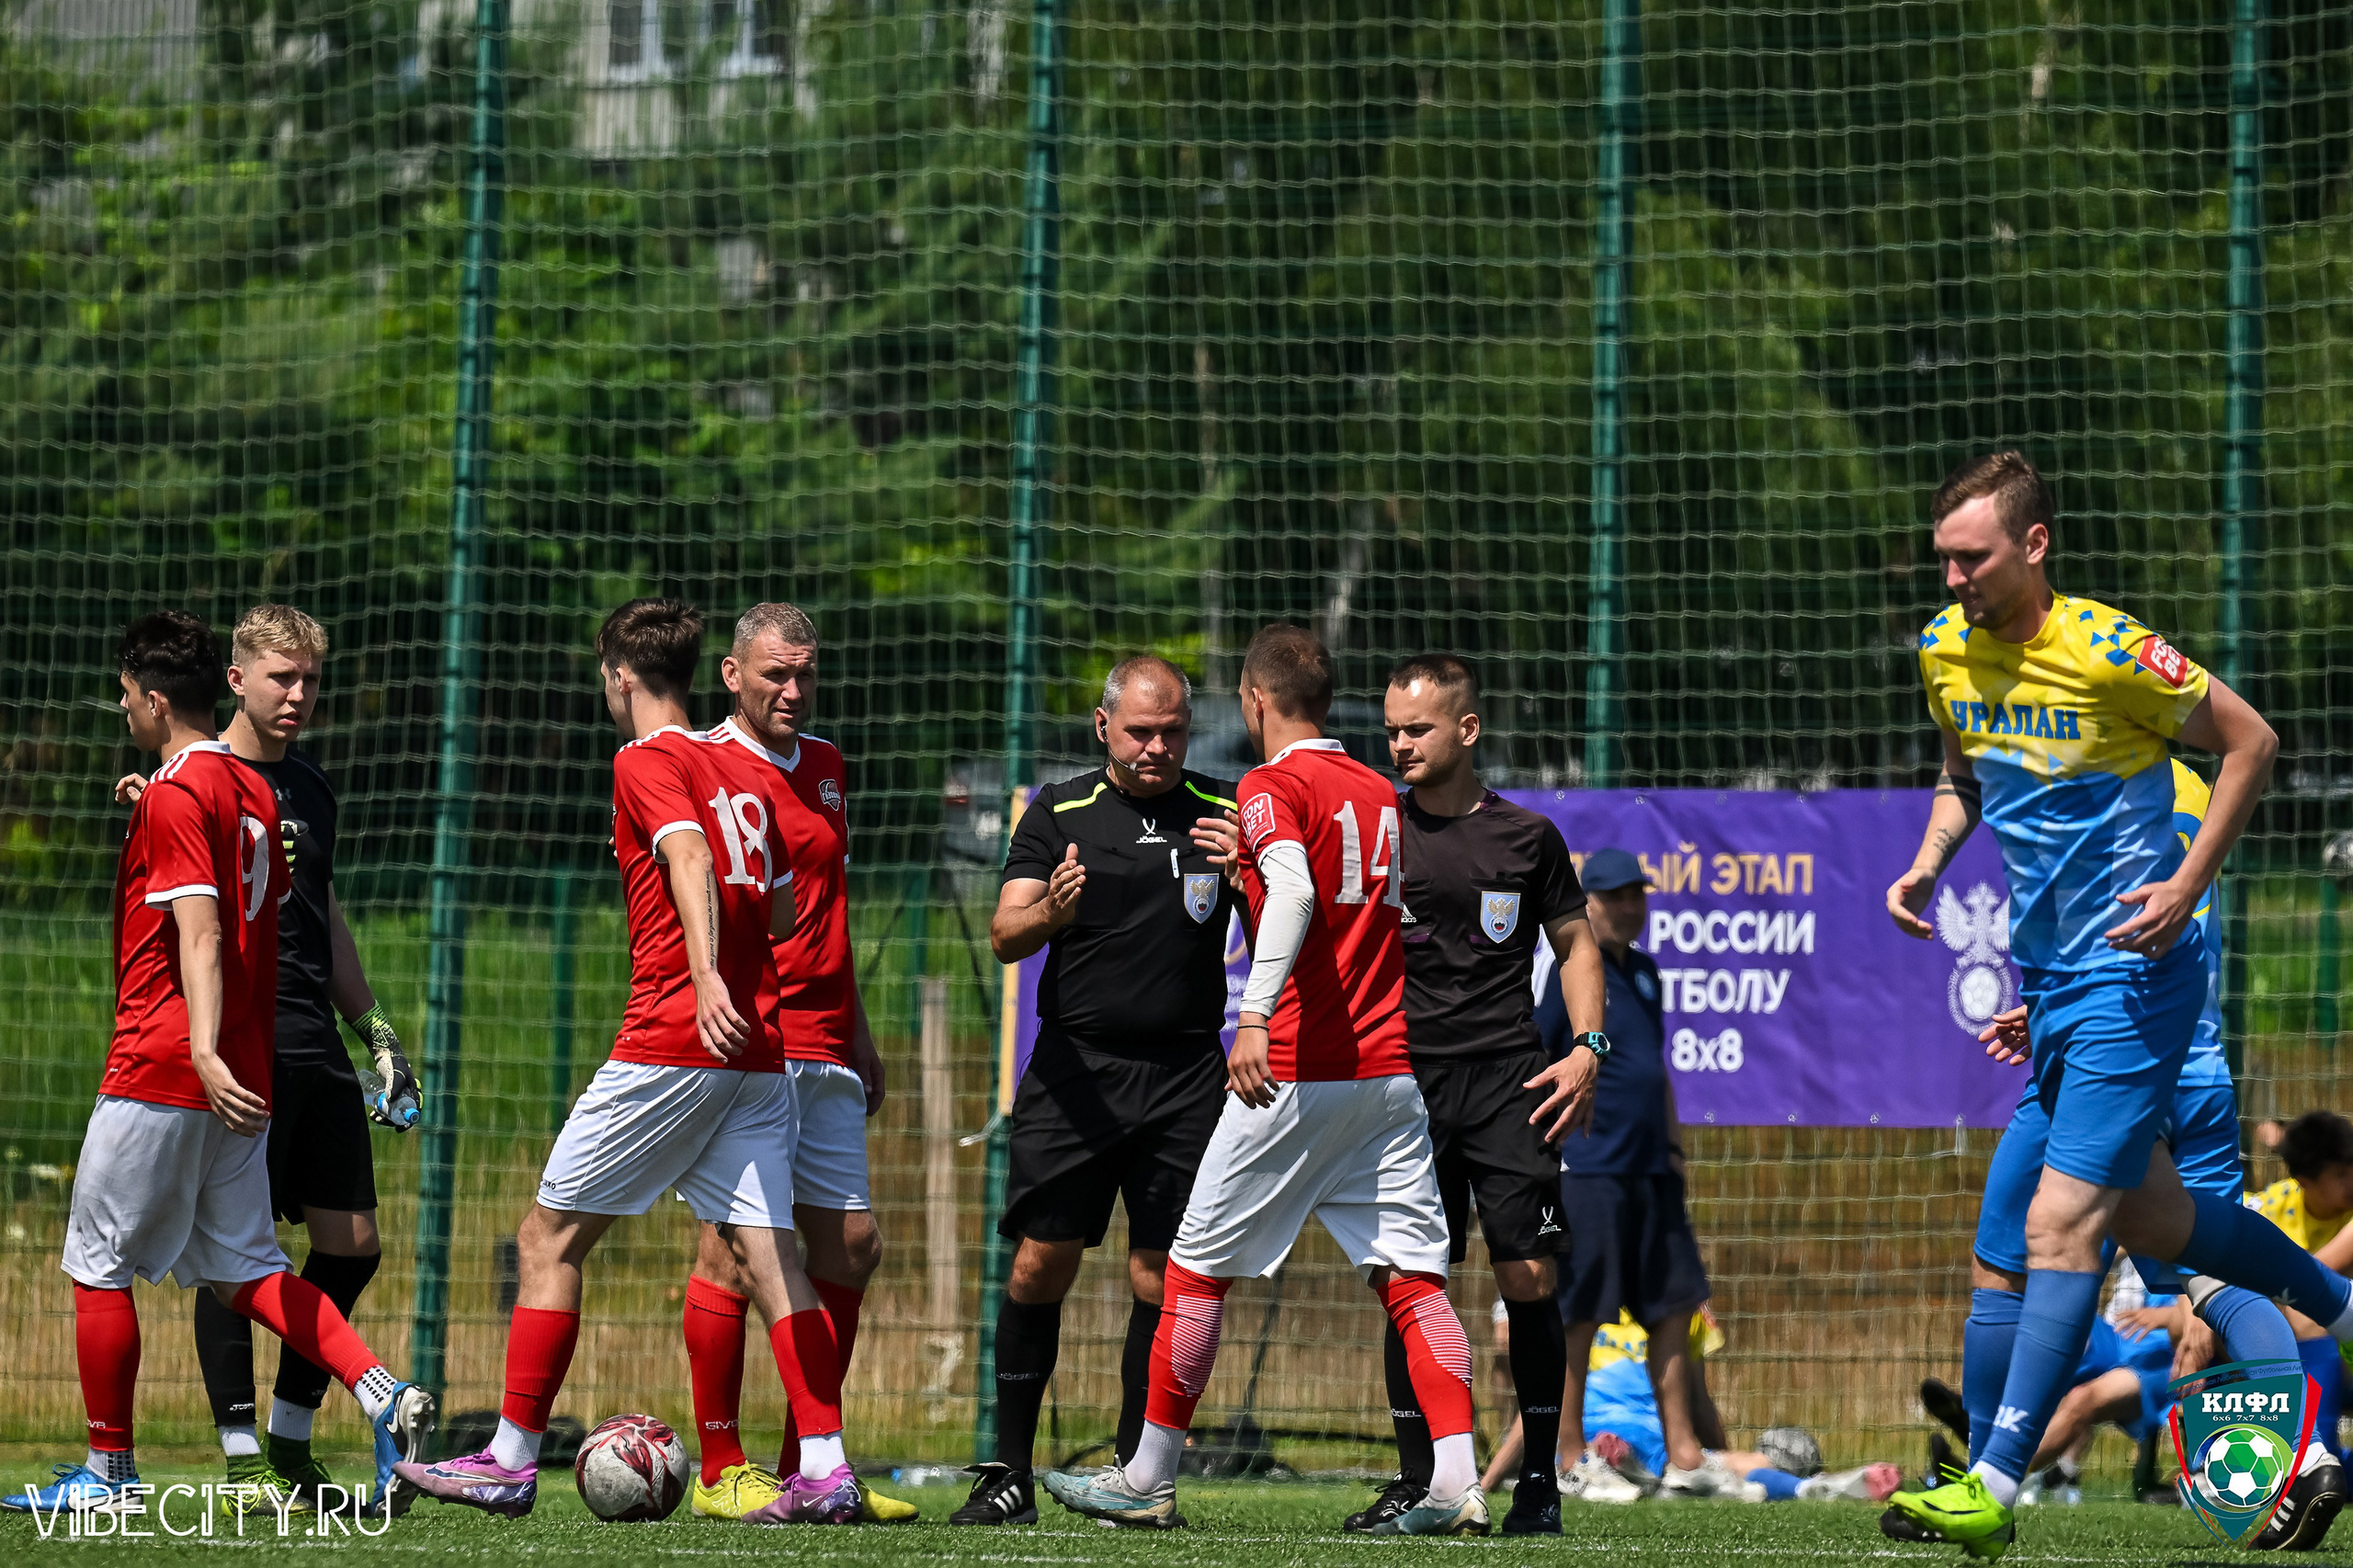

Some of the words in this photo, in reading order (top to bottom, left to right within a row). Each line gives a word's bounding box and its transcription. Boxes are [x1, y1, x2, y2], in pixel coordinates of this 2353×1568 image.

[2151, 640, 2167, 670] FO
[1950, 700, 2081, 740] УРАЛАН
[709, 787, 772, 892] 18
[1334, 800, 1405, 909] 14
[240, 816, 270, 922] 9
[1711, 852, 1814, 895] ЭТАП
[1648, 909, 1815, 955] РОССИИ
[1658, 967, 1791, 1014] ТБОЛУ
